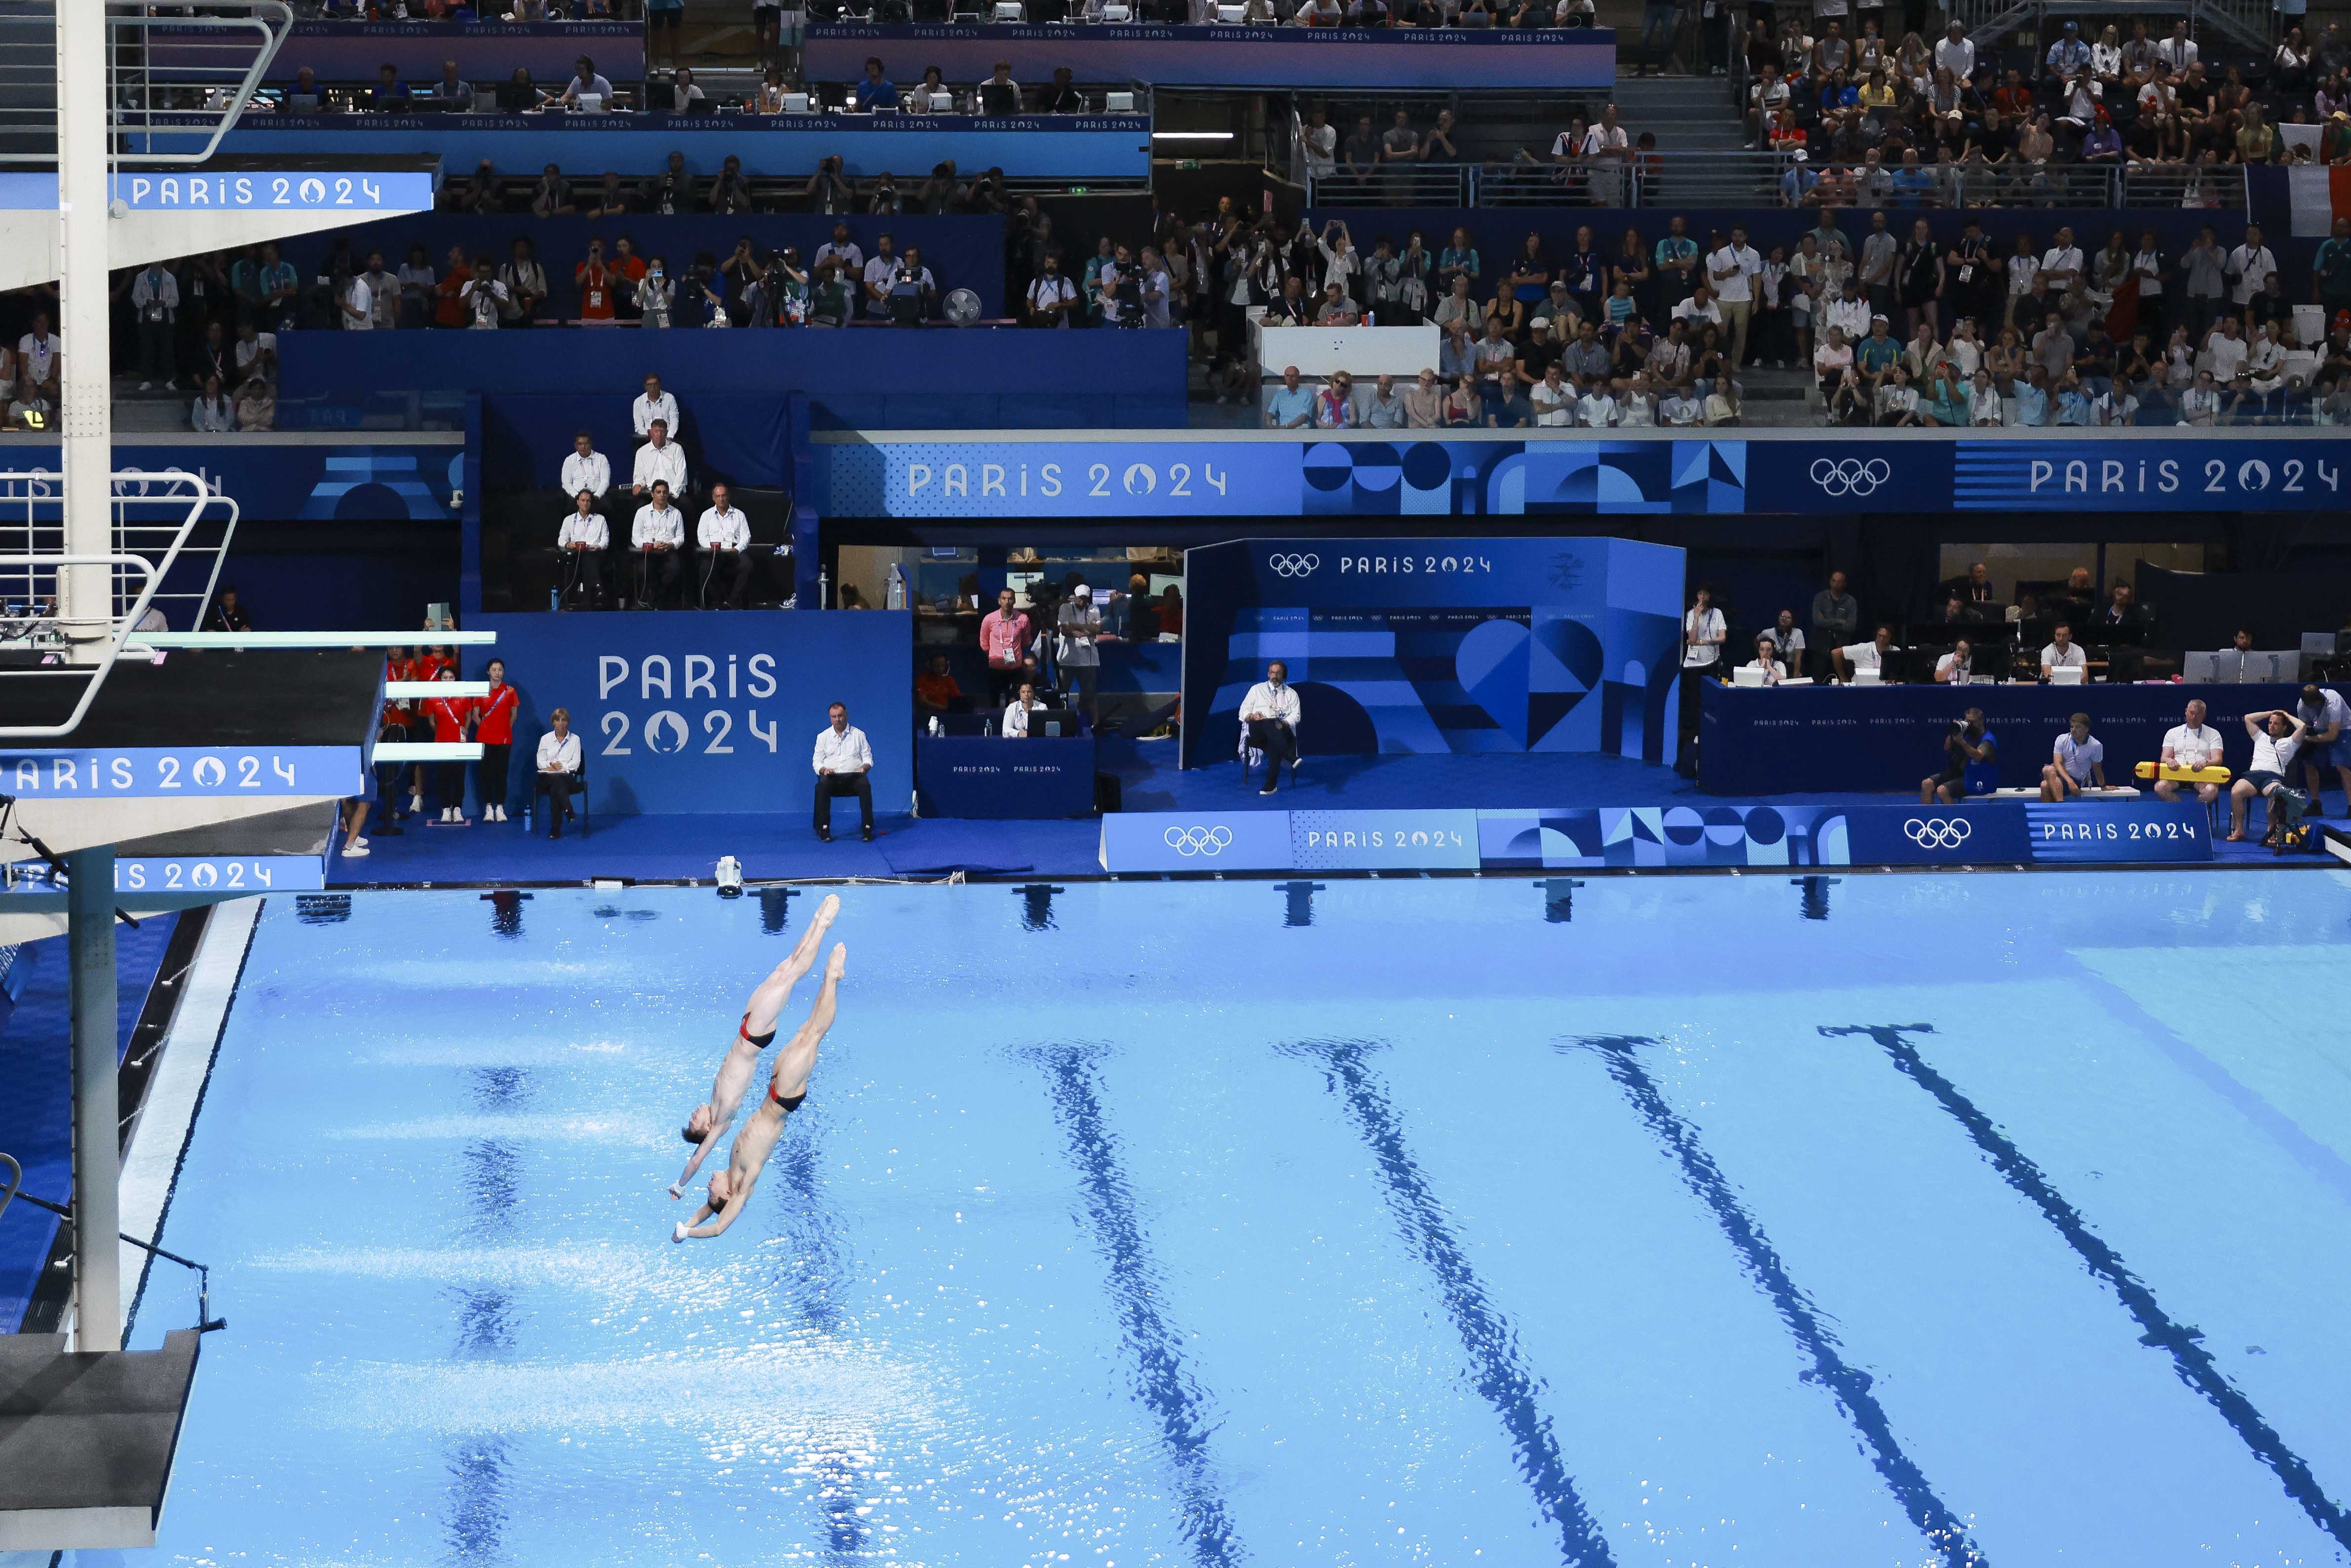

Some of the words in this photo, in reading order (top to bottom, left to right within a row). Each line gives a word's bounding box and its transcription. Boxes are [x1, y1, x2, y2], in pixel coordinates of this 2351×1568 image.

[273, 178, 379, 203] 2024
[1089, 464, 1225, 496] 2024
[2204, 460, 2338, 492] 2024
[1426, 557, 1490, 572] 2024
[601, 710, 777, 755] 2024
[0, 757, 133, 789] ARiS
[159, 756, 294, 787] 2024
[1395, 831, 1462, 846] 2024
[2128, 823, 2194, 839] 2024
[165, 863, 272, 888] 2024
